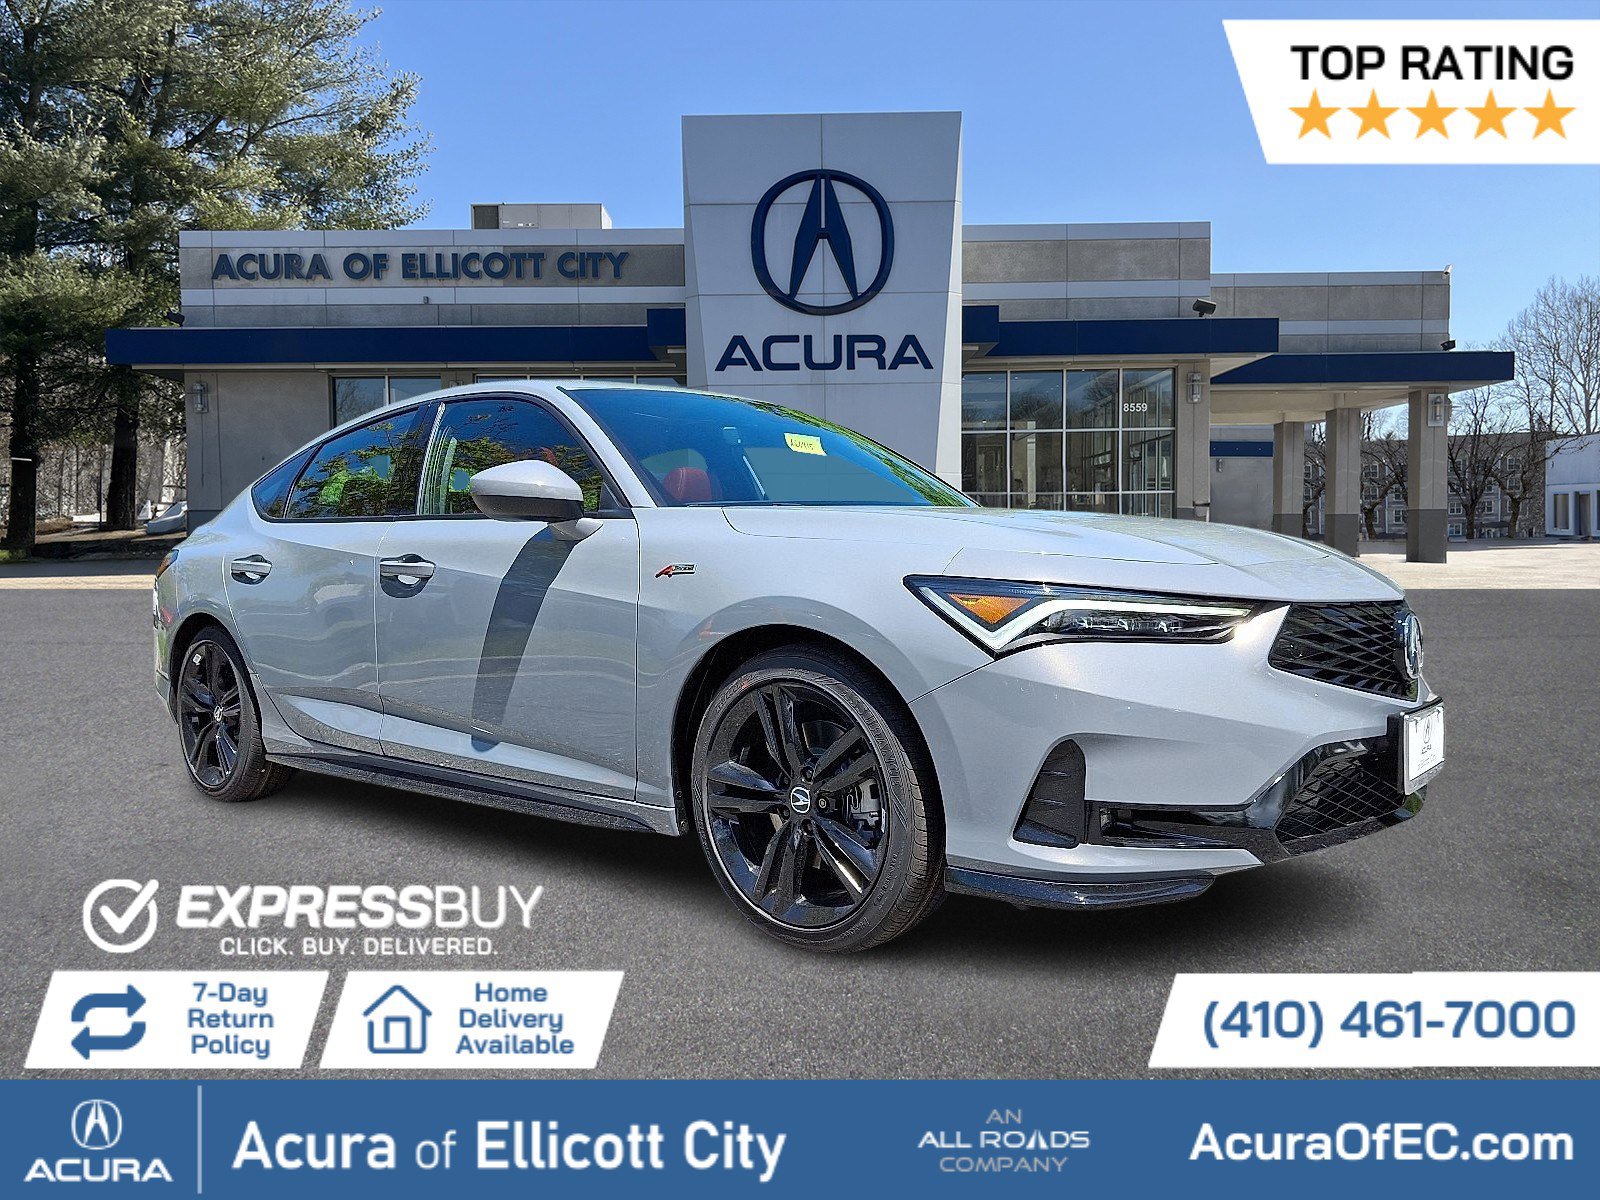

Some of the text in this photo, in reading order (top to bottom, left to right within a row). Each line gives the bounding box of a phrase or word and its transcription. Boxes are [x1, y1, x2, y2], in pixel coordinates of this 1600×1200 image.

[212, 251, 629, 280] ACURA OF ELLICOTT CITY
[715, 334, 934, 371] ACURA
[1122, 402, 1149, 413] 8559
